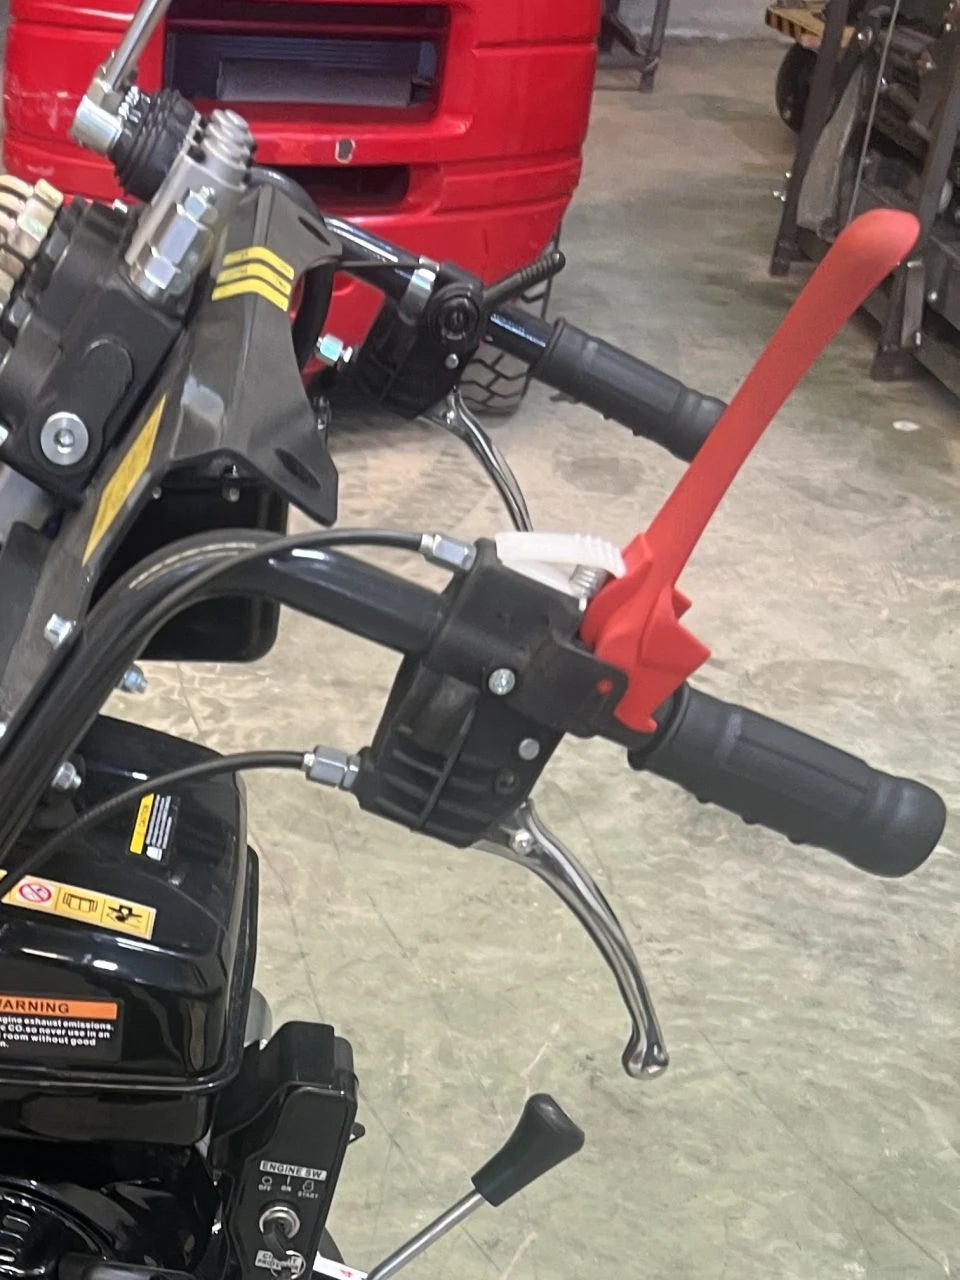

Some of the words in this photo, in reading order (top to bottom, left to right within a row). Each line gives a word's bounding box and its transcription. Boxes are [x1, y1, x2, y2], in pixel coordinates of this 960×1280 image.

[24, 1018, 61, 1028] exhaust
[3, 1032, 29, 1041] room
[30, 1034, 69, 1045] without
[70, 1037, 96, 1047] good
[39, 1026, 66, 1036] never
[67, 1029, 86, 1037] use
[86, 1029, 97, 1038] in
[98, 1031, 111, 1039] an
[262, 1162, 303, 1176] ENGINE
[258, 1183, 272, 1192] OFF
[280, 1184, 292, 1193] ON
[298, 1190, 319, 1199] START
